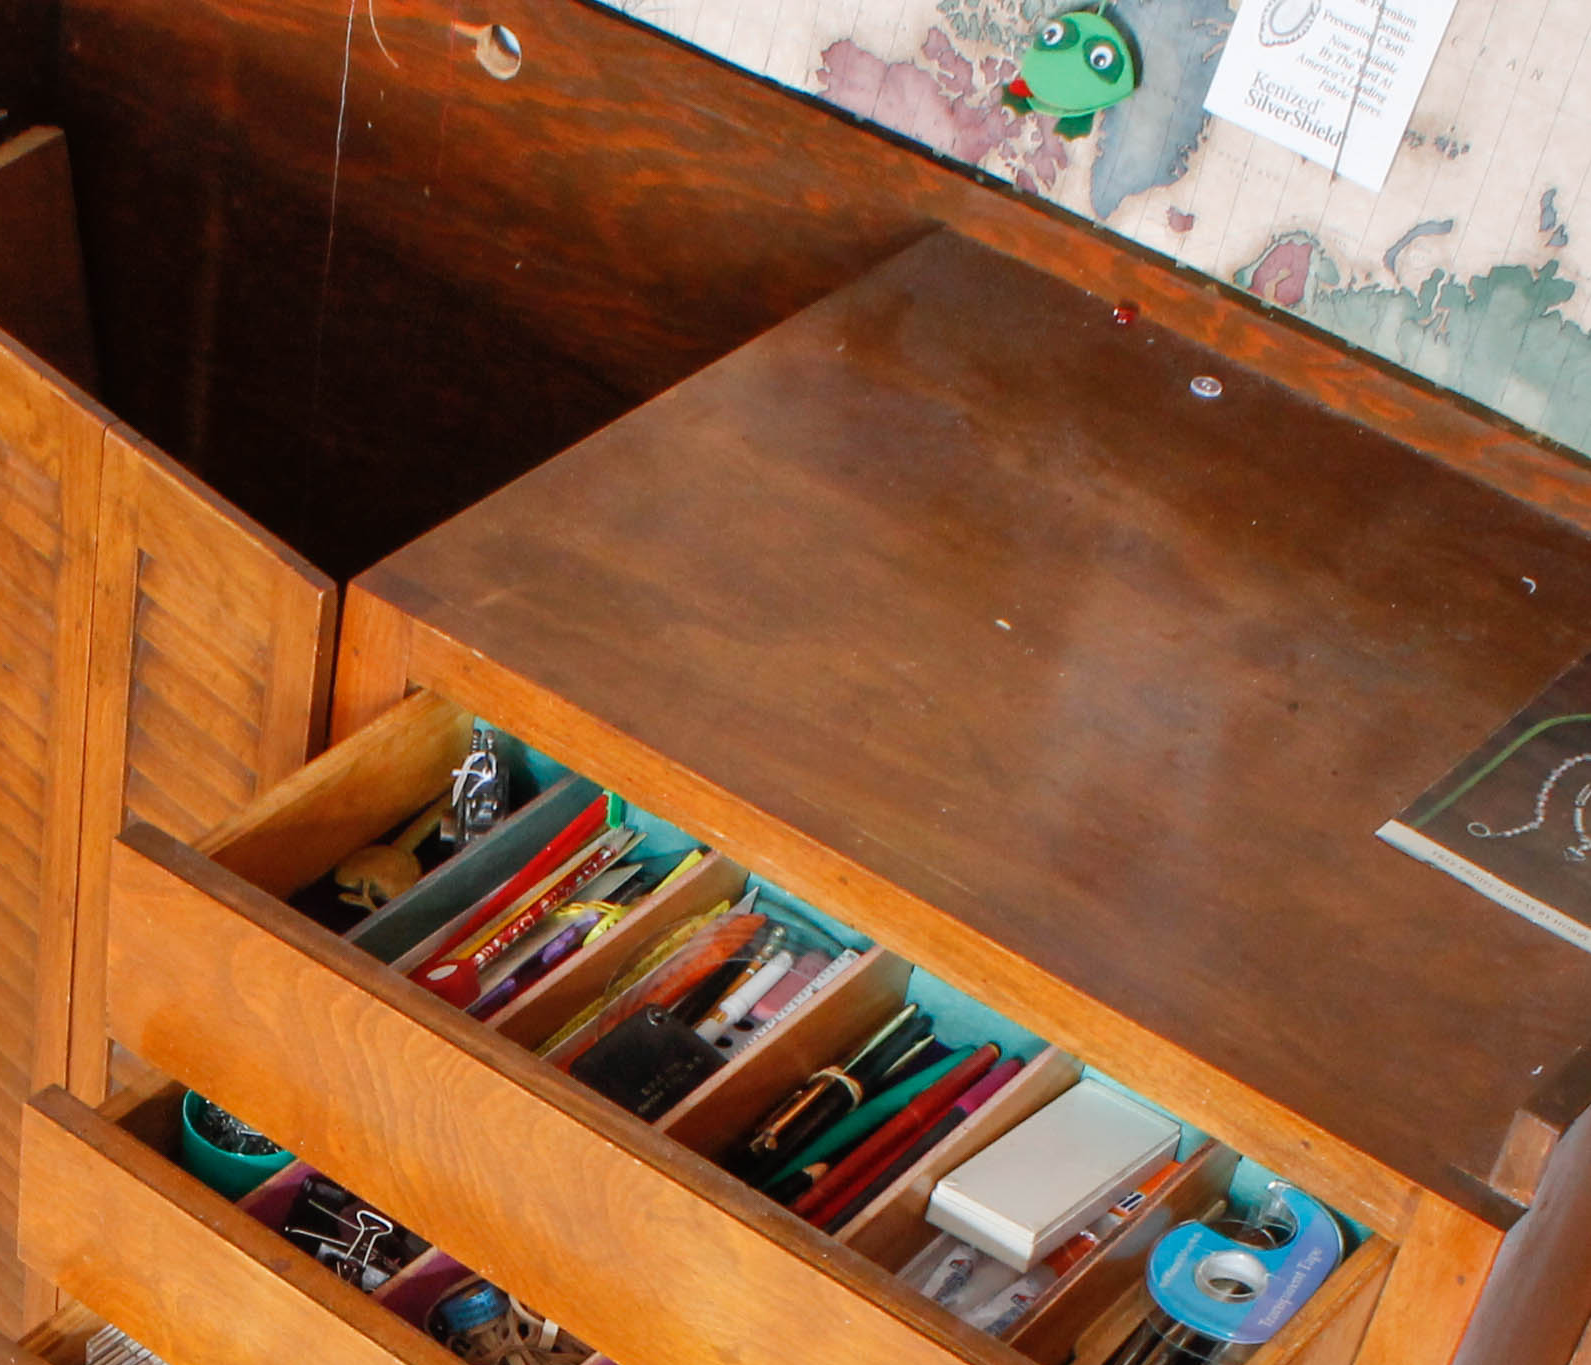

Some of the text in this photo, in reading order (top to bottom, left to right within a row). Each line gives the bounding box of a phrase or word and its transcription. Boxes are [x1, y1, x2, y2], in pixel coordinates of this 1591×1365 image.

[1375, 19, 1414, 43] arnish-
[1243, 89, 1344, 149] SilverShield
[1251, 70, 1320, 116] Kenized
[1257, 1246, 1324, 1328] Transparent Tape
